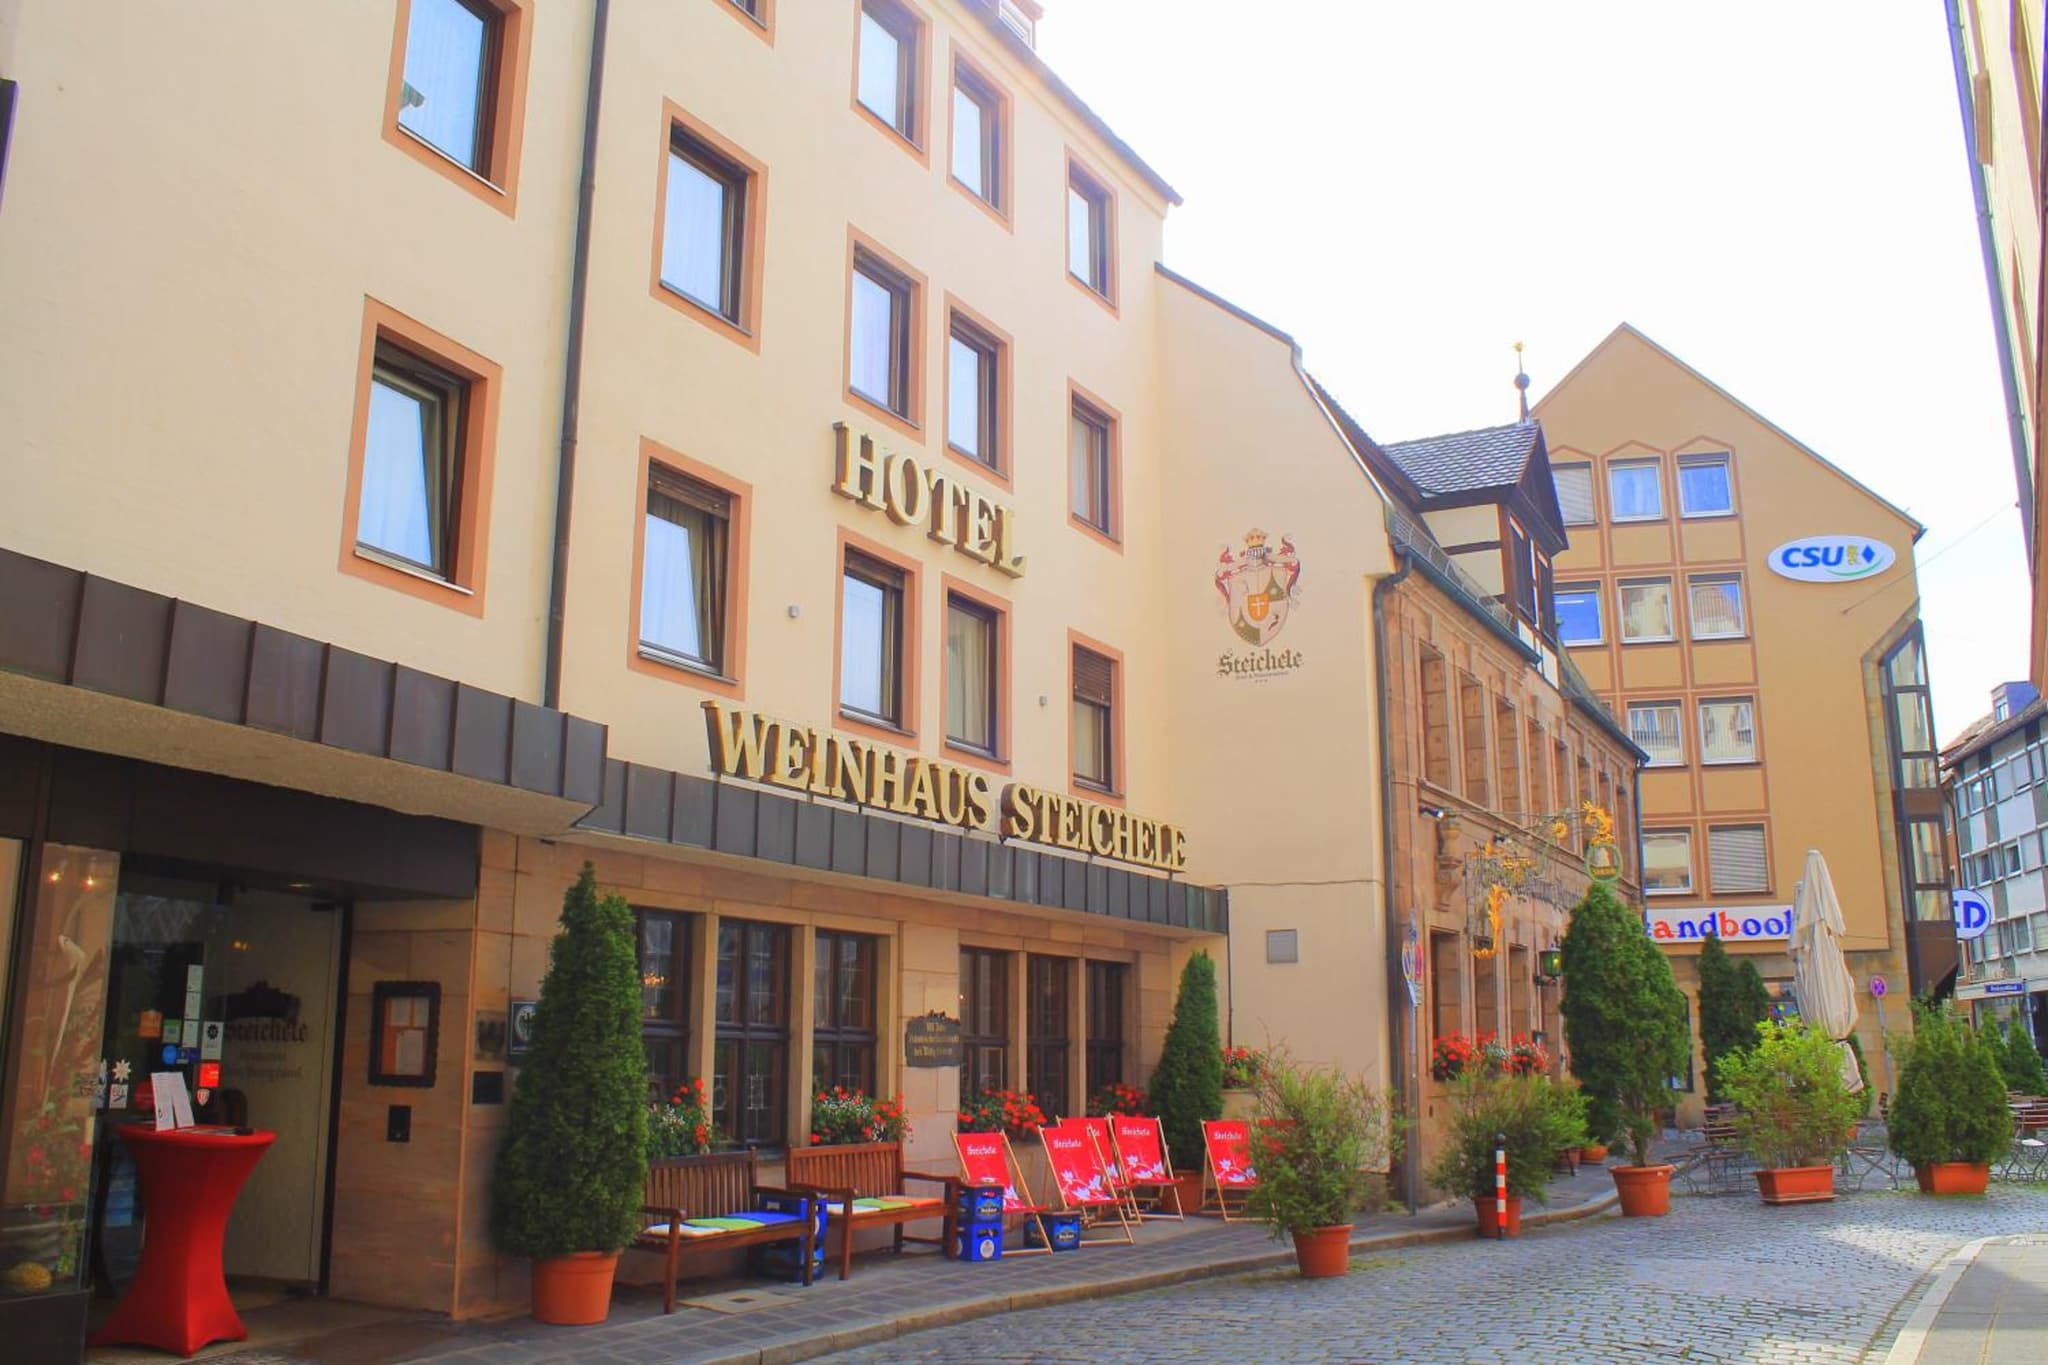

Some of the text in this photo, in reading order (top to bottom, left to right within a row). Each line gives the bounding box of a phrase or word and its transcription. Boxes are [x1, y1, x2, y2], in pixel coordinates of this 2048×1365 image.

[832, 420, 1027, 578] HOTEL
[1781, 546, 1844, 568] CSU
[1217, 648, 1304, 677] Steichele
[700, 700, 1188, 872] WEINHAUS STEICHELE
[1953, 899, 1988, 929] D
